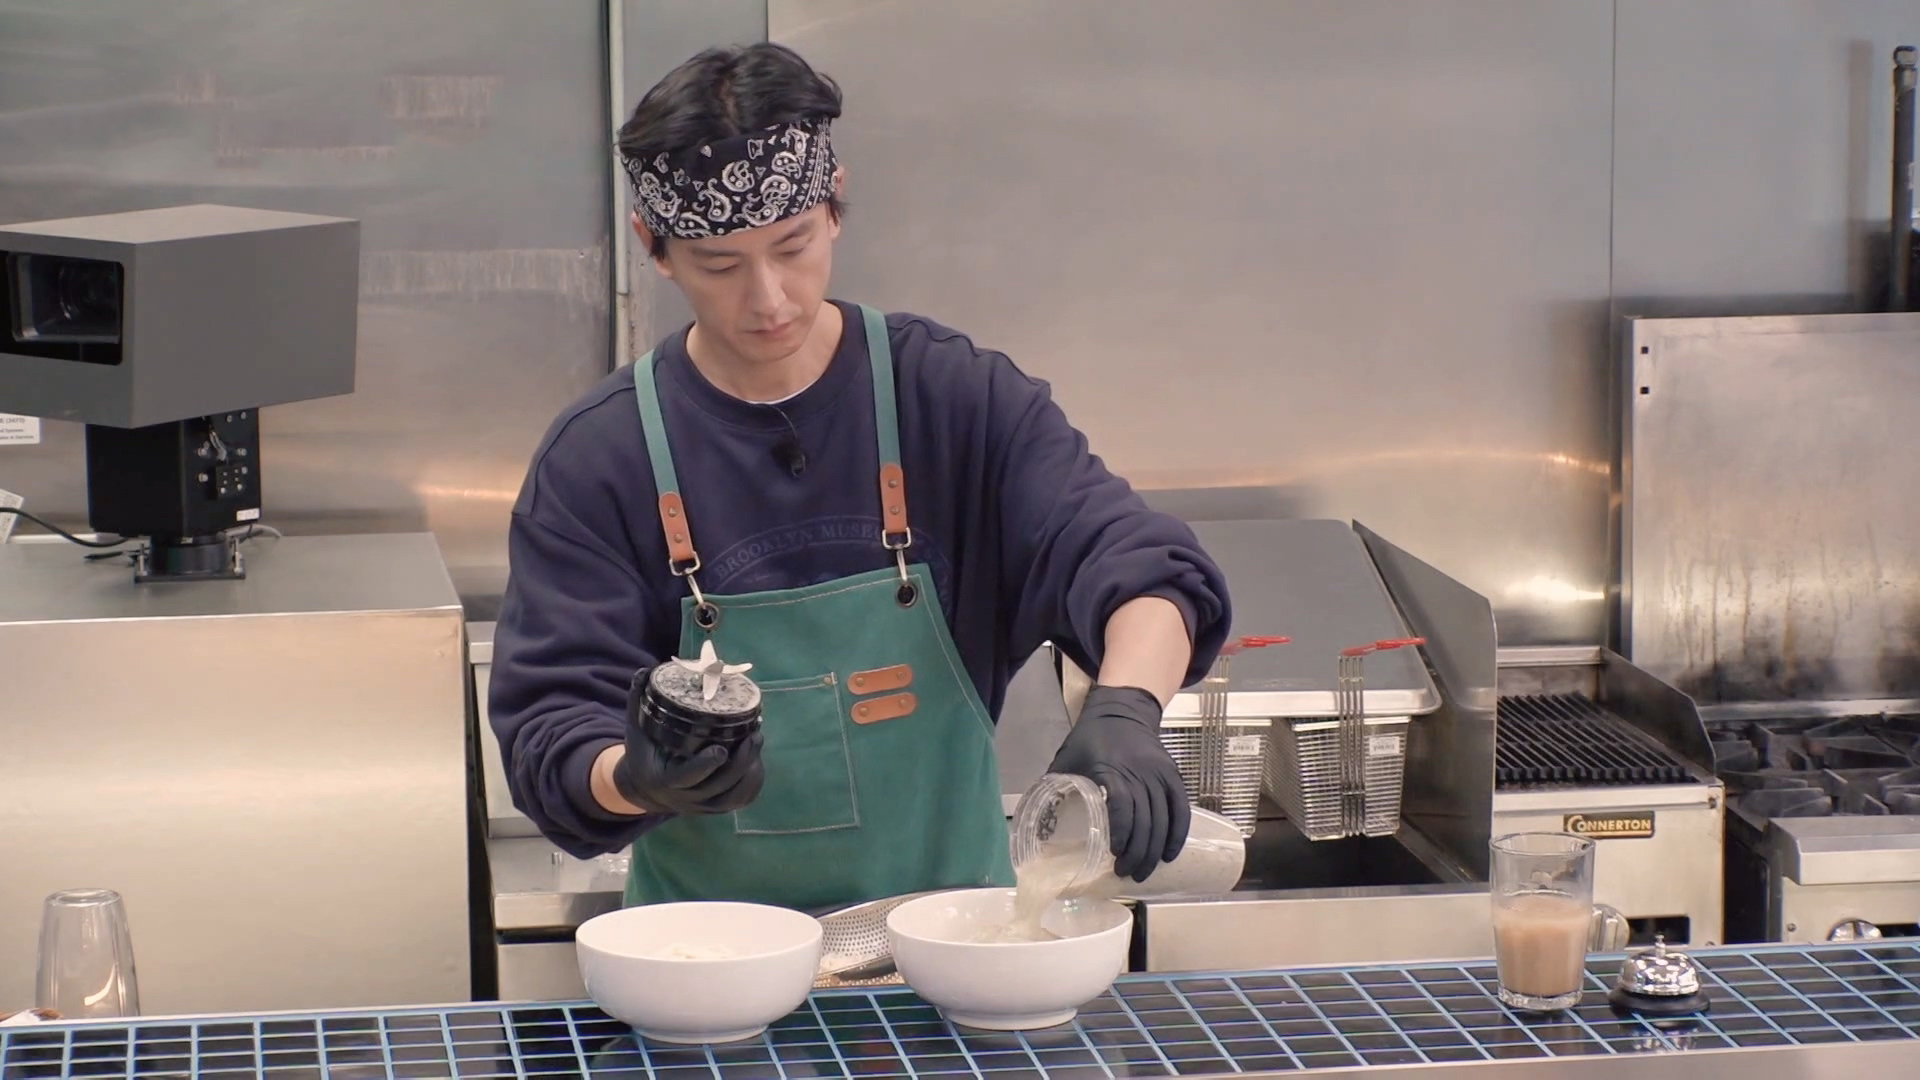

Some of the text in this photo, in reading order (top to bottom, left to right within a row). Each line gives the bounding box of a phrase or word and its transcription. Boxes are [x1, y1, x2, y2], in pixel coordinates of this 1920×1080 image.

[715, 522, 882, 580] BROOKLYN MUSE
[1567, 815, 1652, 834] CONNERTON
